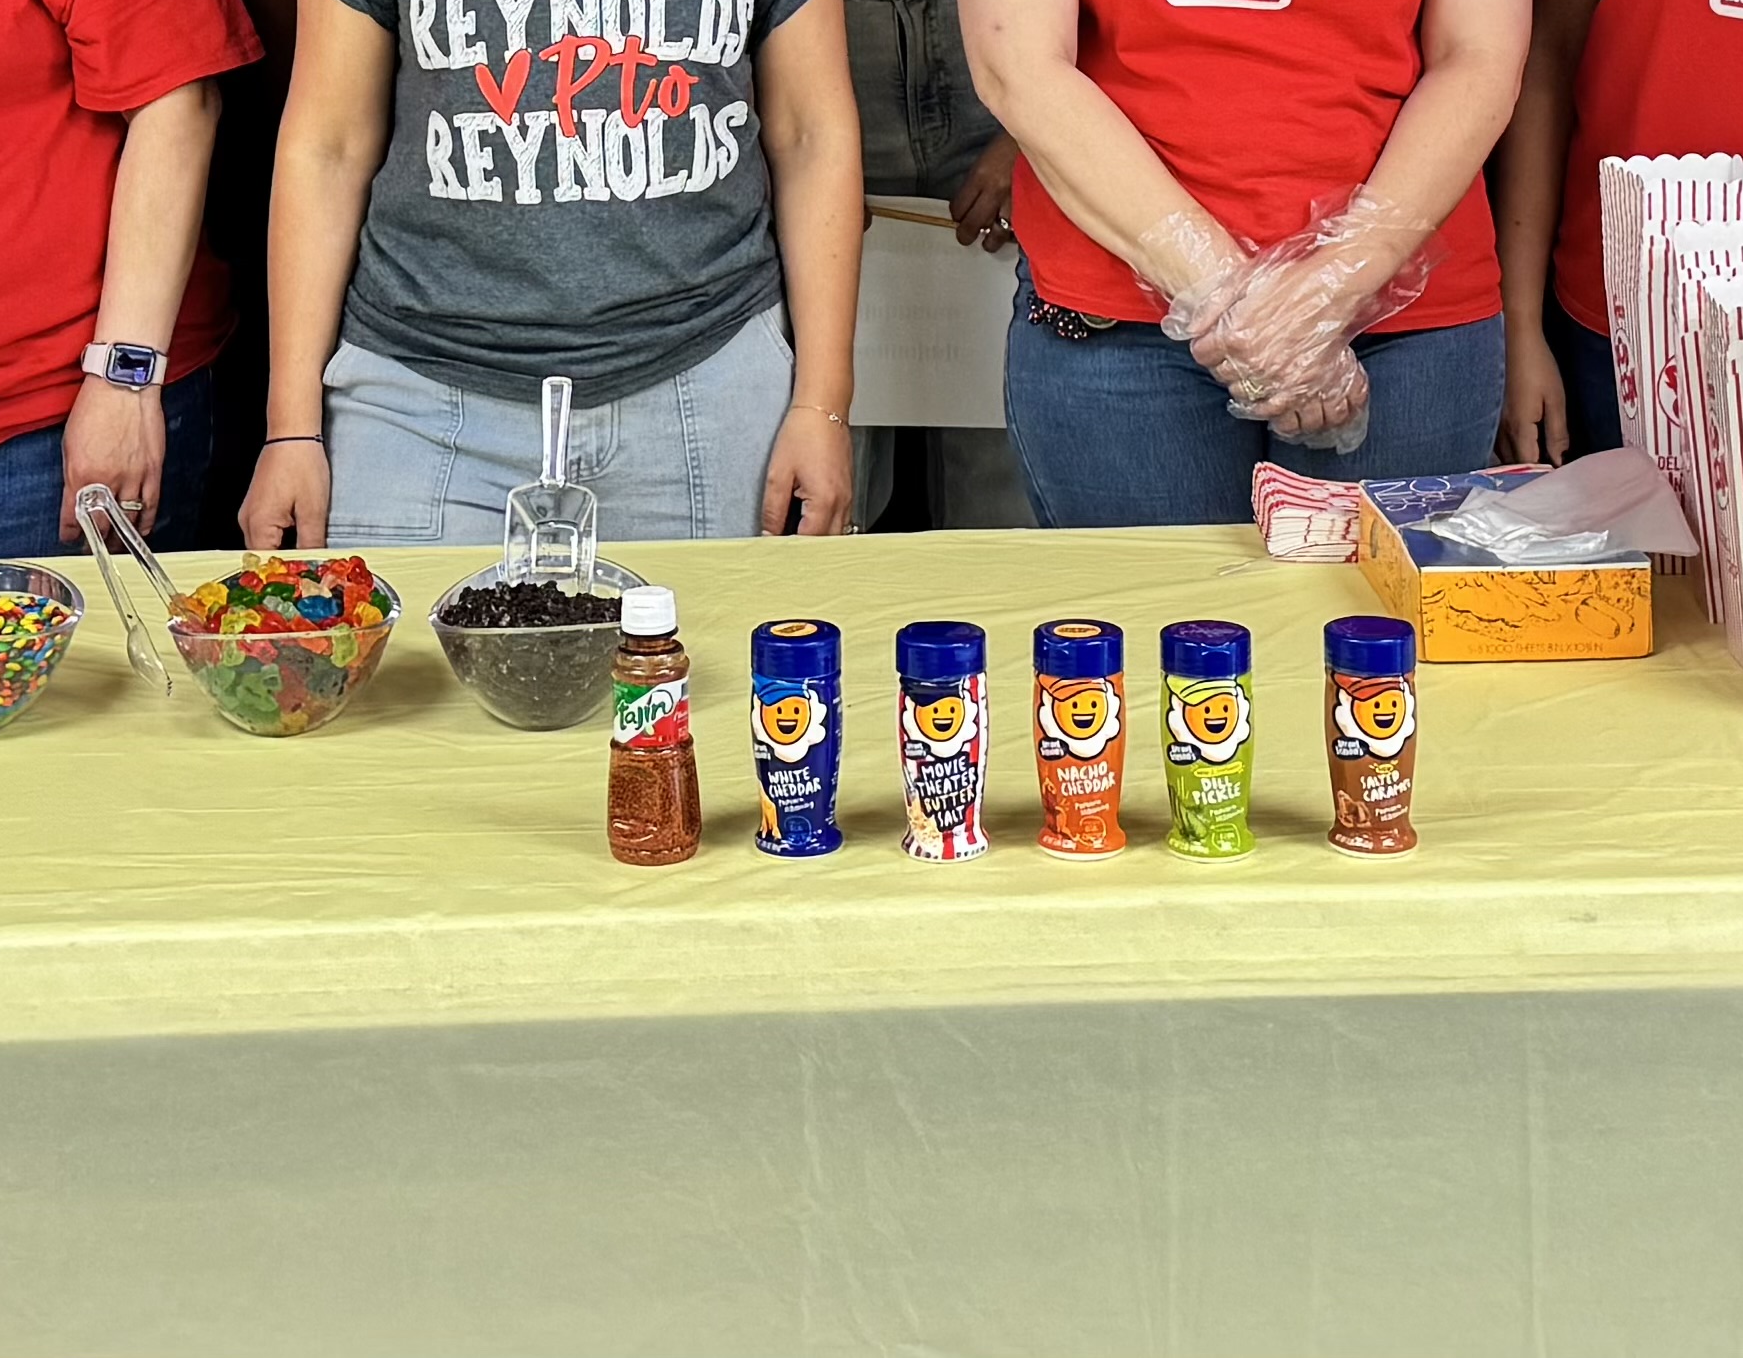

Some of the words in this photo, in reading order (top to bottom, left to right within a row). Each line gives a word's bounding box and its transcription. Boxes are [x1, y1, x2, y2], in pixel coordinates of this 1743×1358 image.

[539, 34, 699, 138] Pto
[427, 100, 749, 206] REYNOLDS
[767, 766, 811, 785] WHITE
[921, 755, 967, 780] MOVIE
[1056, 761, 1108, 782] NACHO
[1360, 769, 1400, 789] SALTED
[768, 777, 822, 799] CHEDDAR
[916, 766, 976, 797] THEATER
[1060, 771, 1116, 797] CHEDDAR
[1191, 781, 1242, 806] PICKLE
[1200, 775, 1233, 792] DILL
[924, 787, 975, 813] BUTTER
[937, 805, 965, 828] SALT
